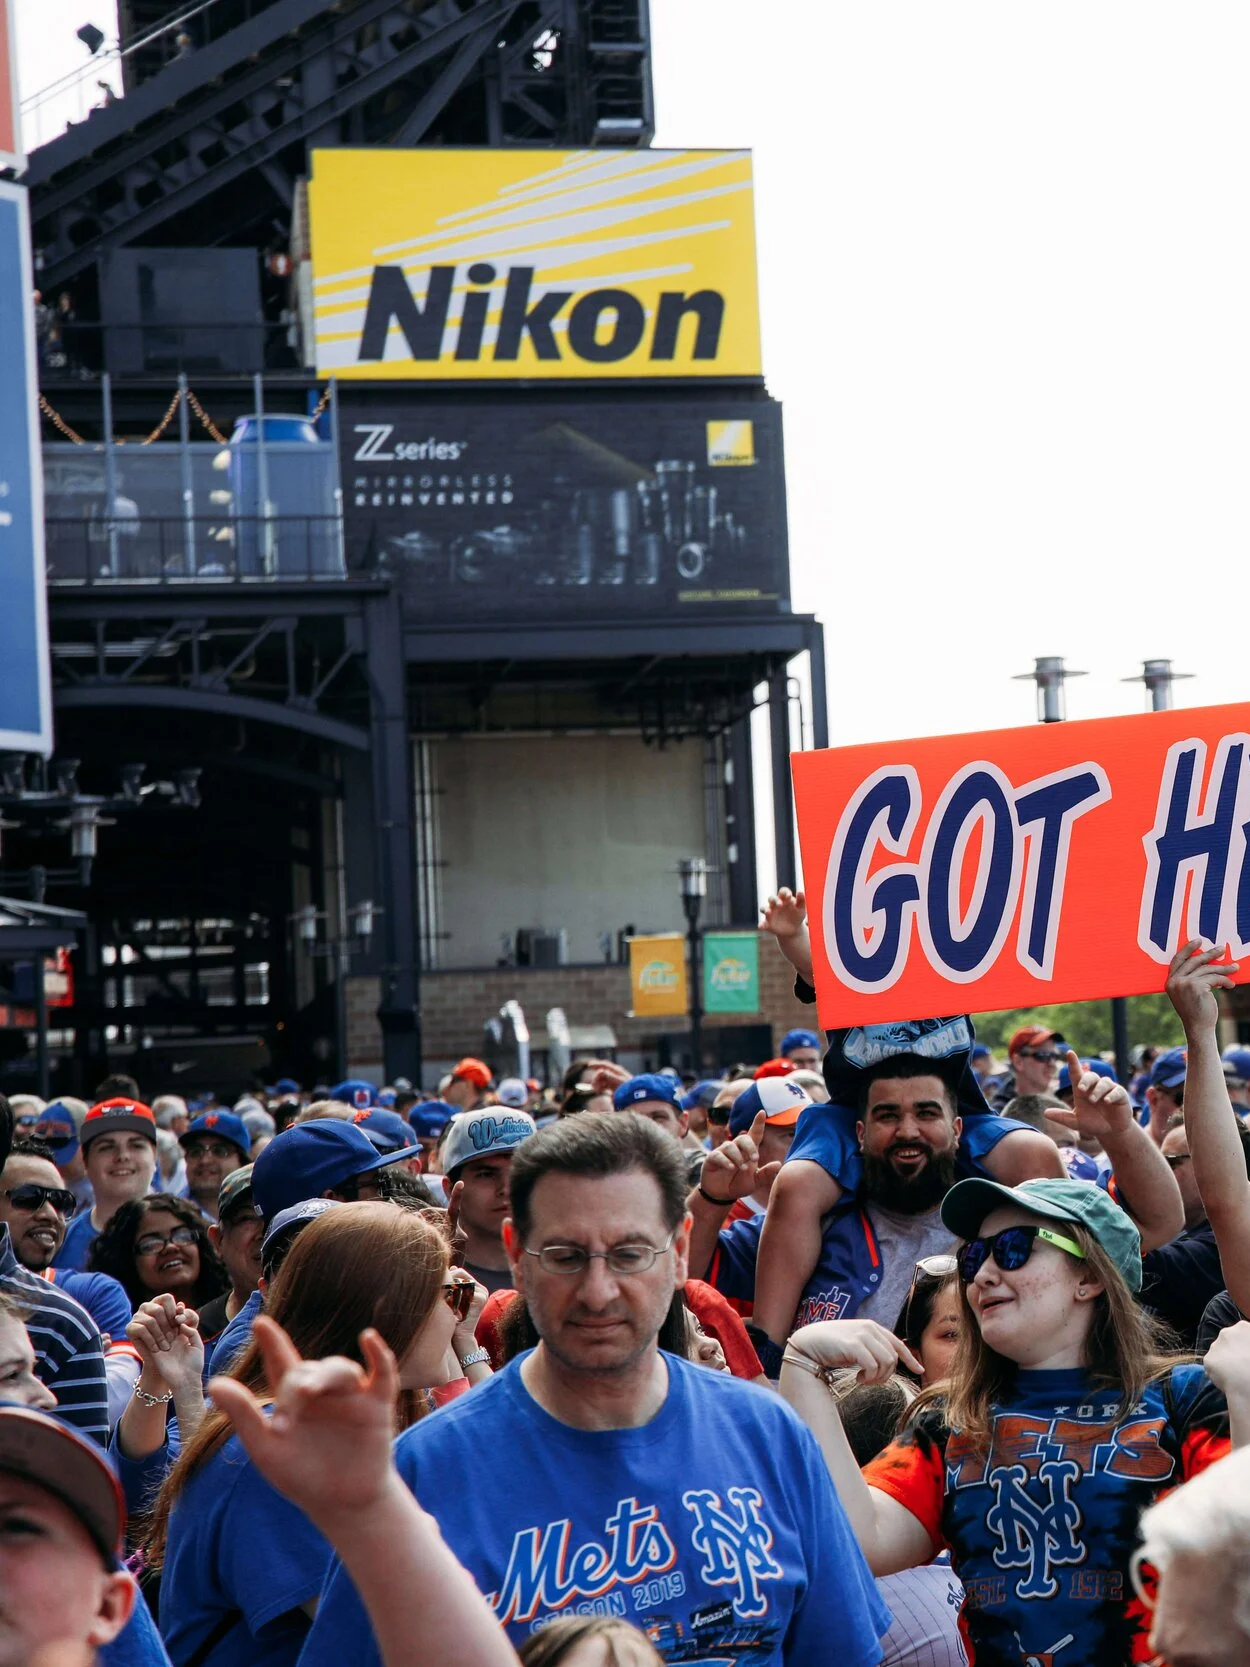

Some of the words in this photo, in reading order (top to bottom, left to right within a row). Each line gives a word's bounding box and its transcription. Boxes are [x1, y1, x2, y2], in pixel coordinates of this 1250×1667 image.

[357, 264, 725, 361] Nikon
[354, 425, 394, 461] Z
[394, 437, 461, 460] series
[826, 764, 1109, 993] GOT
[912, 1023, 970, 1059] WORLD
[944, 1412, 1176, 1496] METS
[490, 1497, 676, 1626] Mets
[682, 1487, 784, 1618] NY
[986, 1459, 1087, 1598] NY
[632, 1571, 686, 1612] 2019
